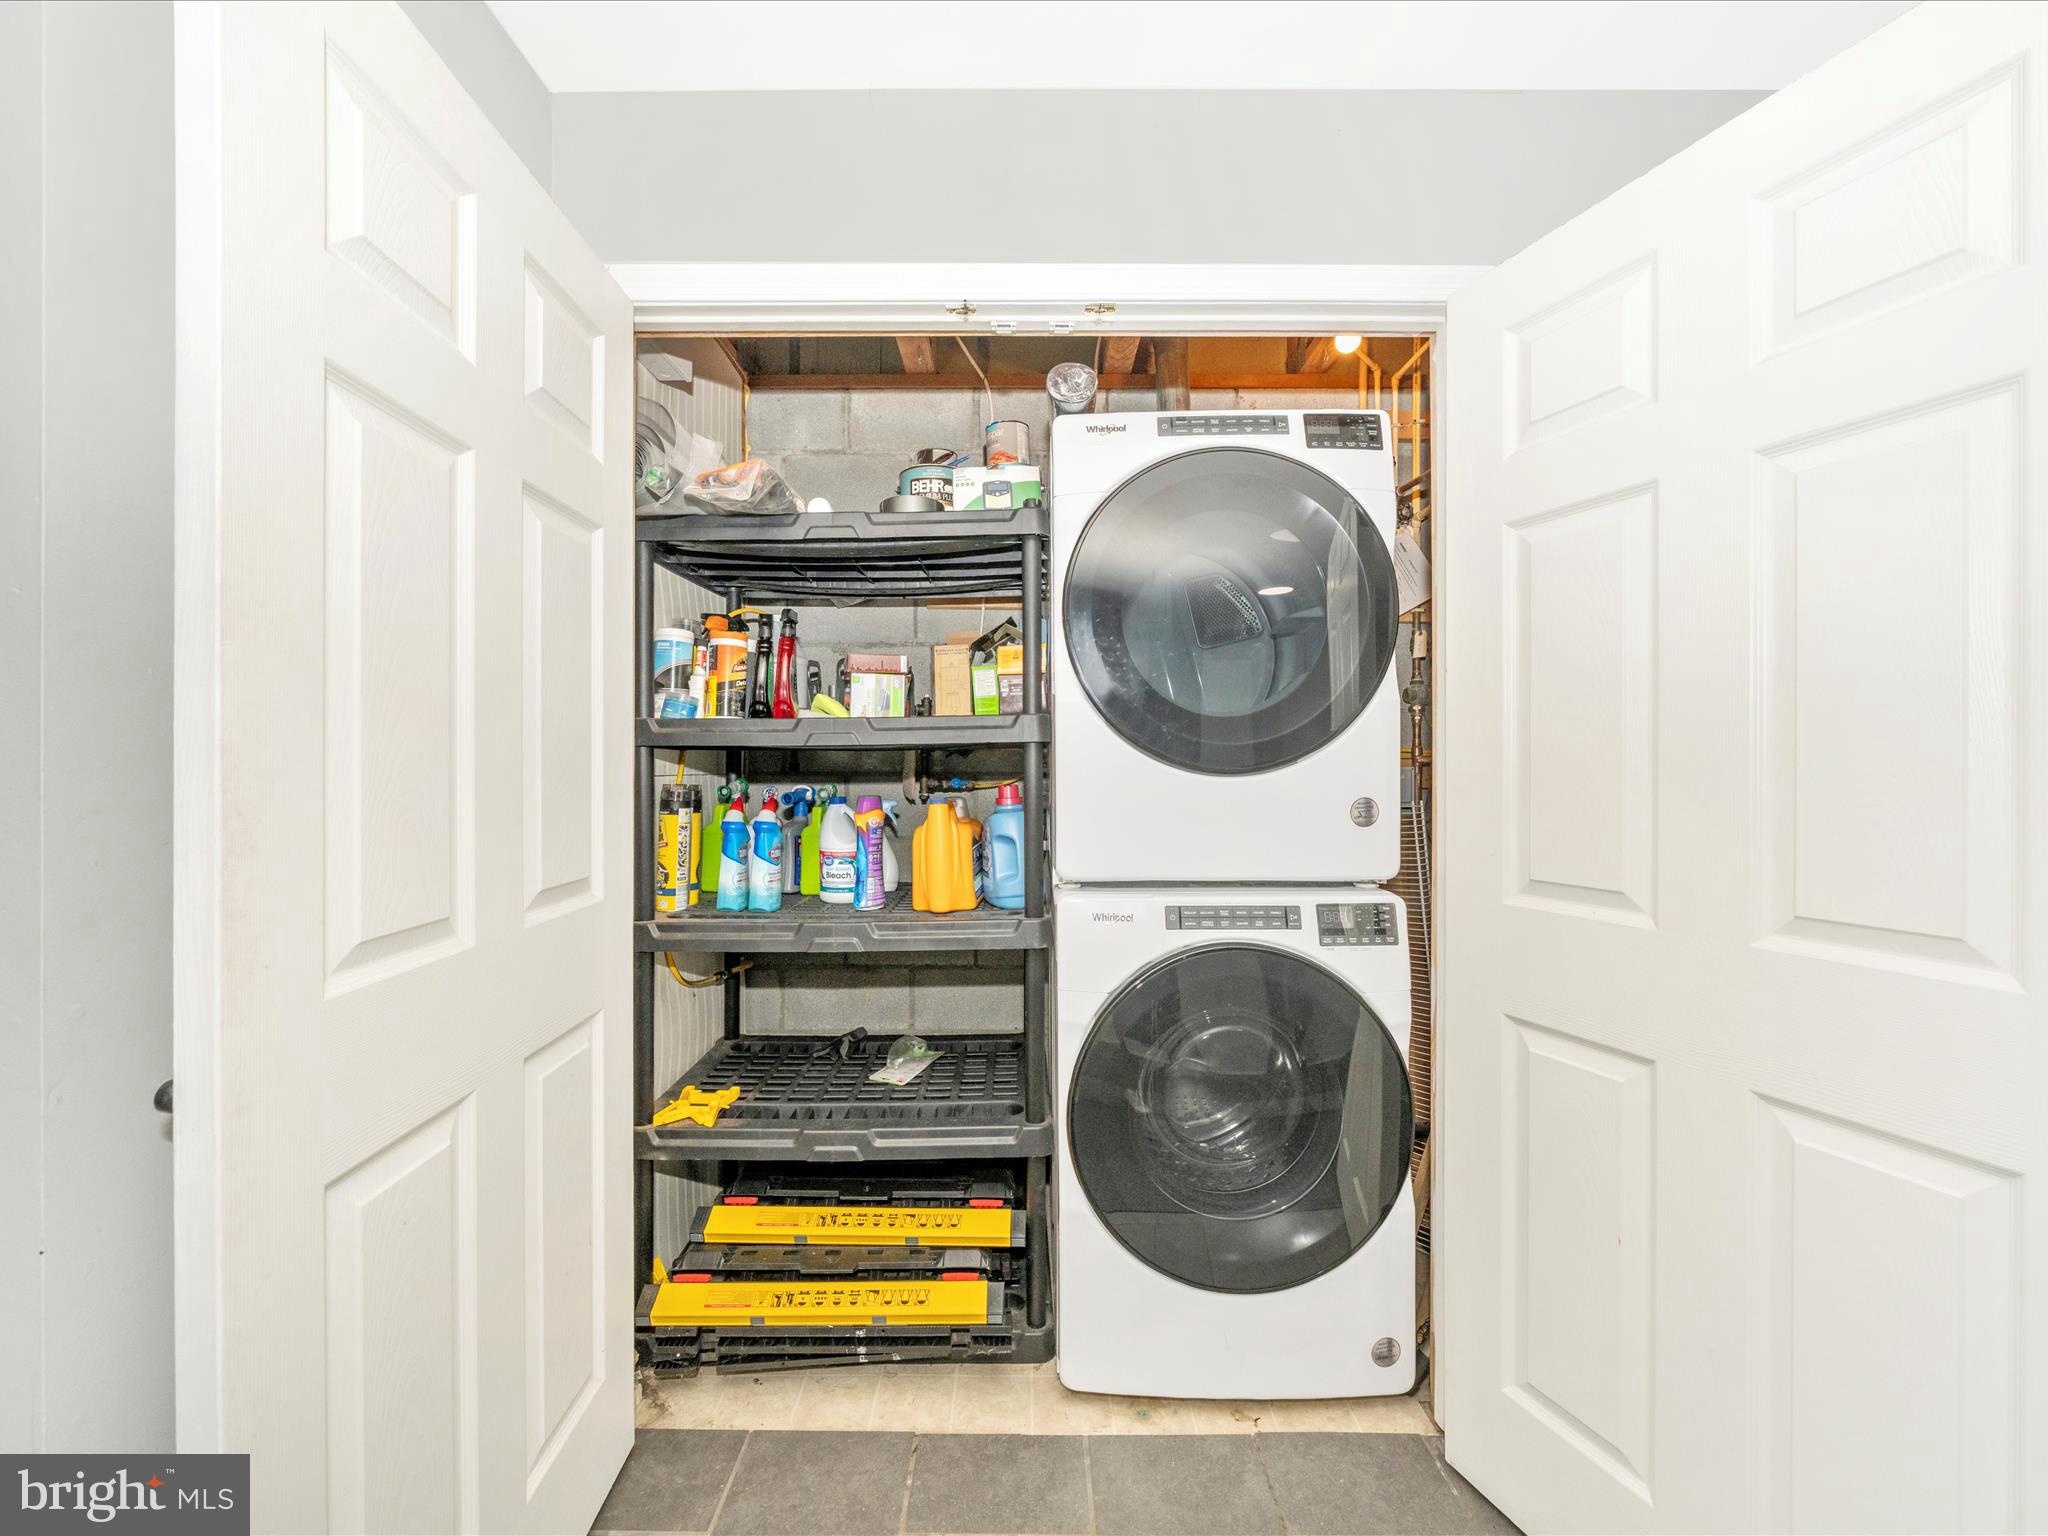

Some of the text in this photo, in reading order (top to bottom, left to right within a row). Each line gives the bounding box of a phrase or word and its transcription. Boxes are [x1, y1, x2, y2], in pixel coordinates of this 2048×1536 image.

[1086, 424, 1127, 435] Whirlpool
[911, 479, 944, 494] BEHR
[826, 871, 852, 880] Bleach
[1091, 912, 1134, 923] Whirlpool
